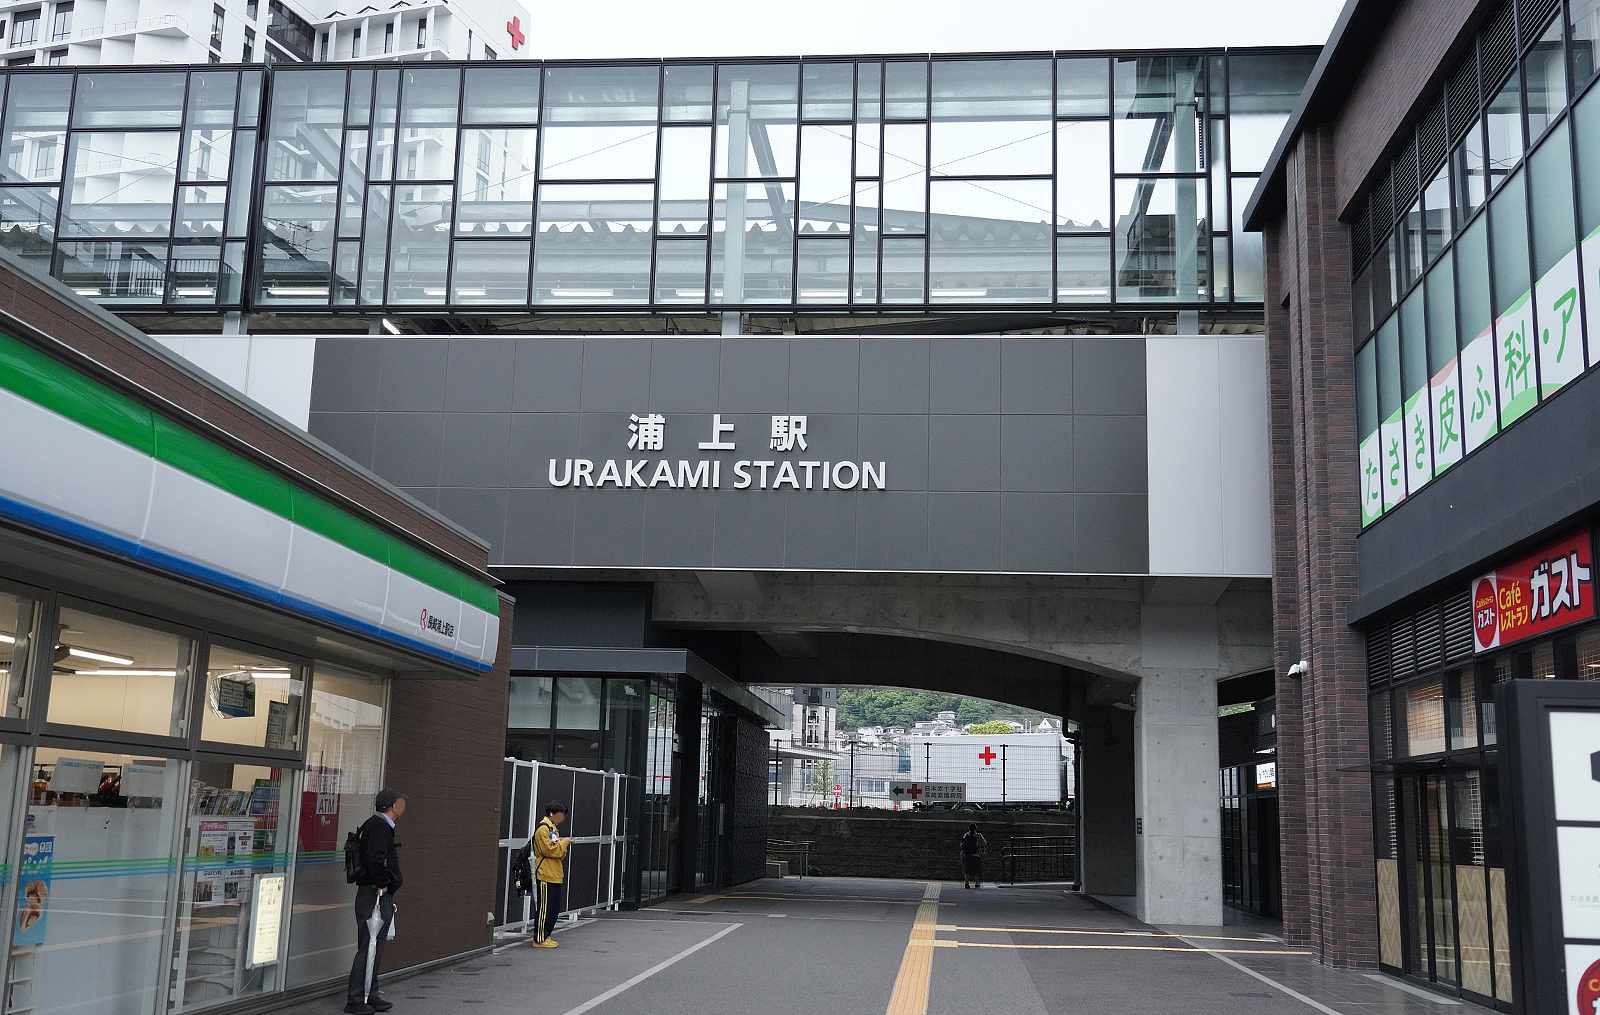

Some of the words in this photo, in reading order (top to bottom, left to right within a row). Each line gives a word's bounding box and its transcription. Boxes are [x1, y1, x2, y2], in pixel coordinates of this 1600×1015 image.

[627, 413, 808, 451] 浦上駅
[548, 459, 720, 488] URAKAMI
[733, 461, 886, 490] STATION
[1499, 581, 1521, 609] Café
[1530, 552, 1590, 620] ガスト
[1477, 608, 1495, 629] ガスト
[1501, 605, 1528, 632] レストラン
[318, 798, 335, 813] ATM
